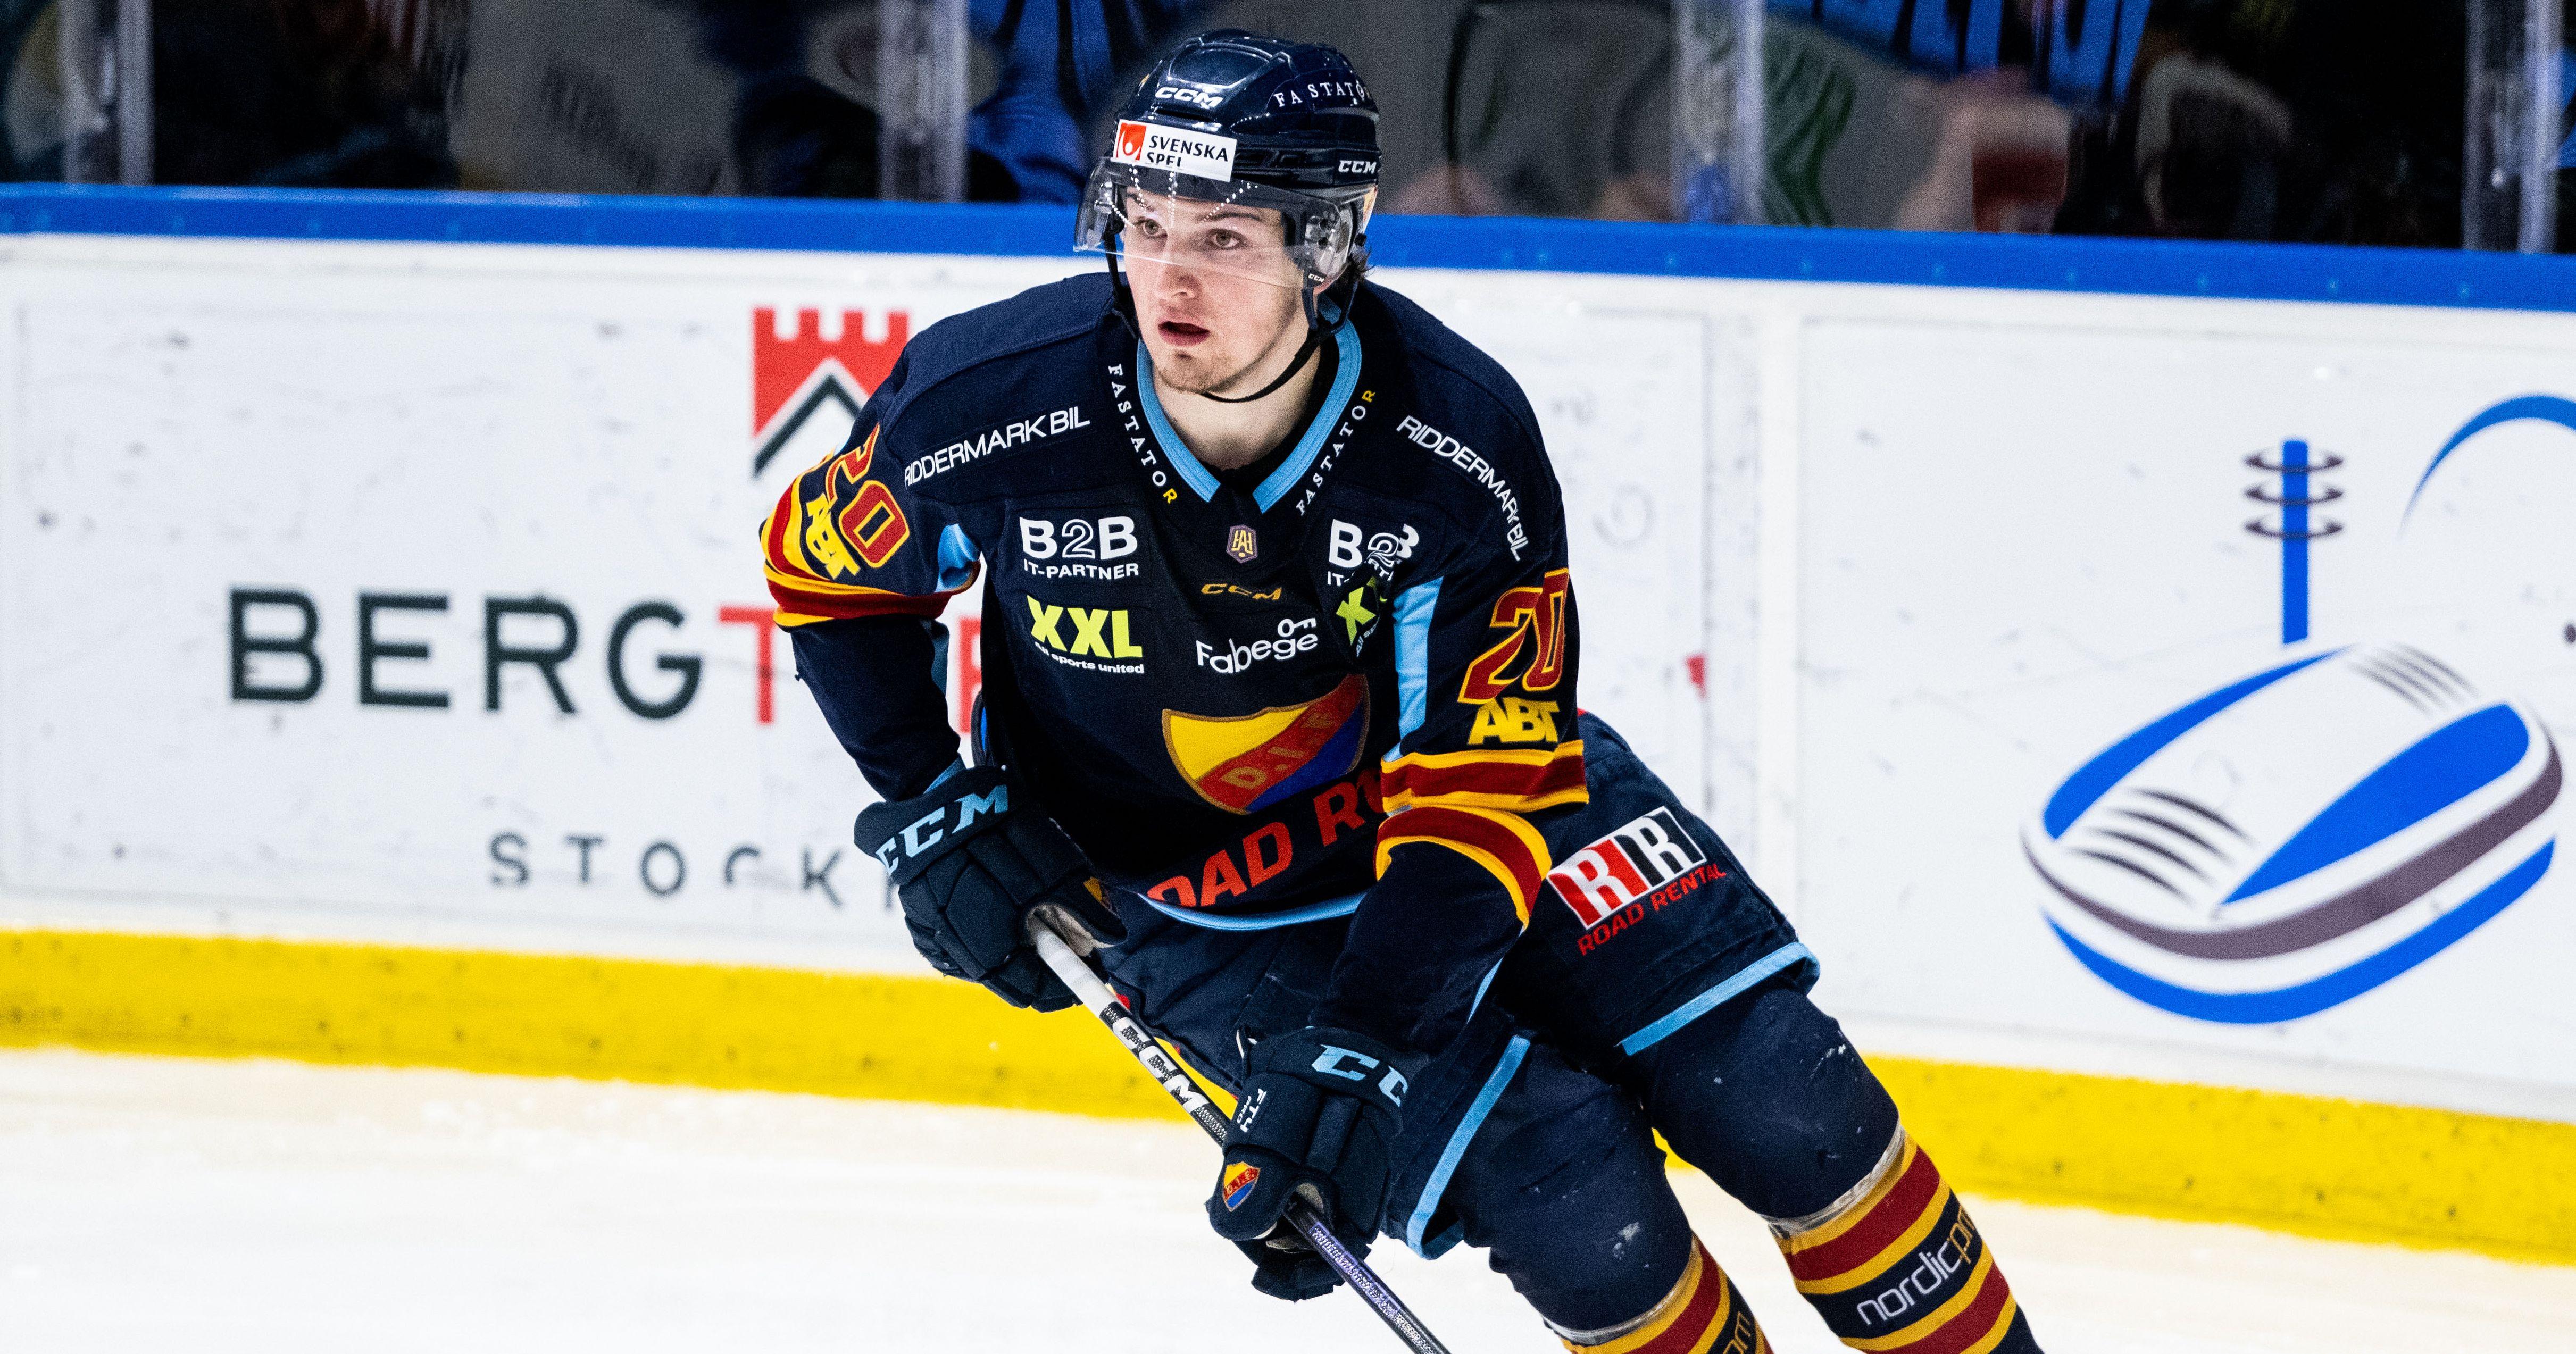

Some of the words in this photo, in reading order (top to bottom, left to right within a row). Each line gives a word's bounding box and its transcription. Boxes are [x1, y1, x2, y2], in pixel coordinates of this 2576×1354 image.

[1155, 87, 1223, 109] CCM
[1149, 135, 1228, 162] SVENSKA
[1338, 160, 1377, 174] CCM
[1308, 273, 1325, 283] CCM
[904, 415, 1047, 489] RIDDERMARK
[1049, 406, 1090, 435] BIL
[1108, 363, 1178, 504] FASTATOR
[1296, 390, 1375, 516] FASTATOR
[1019, 516, 1138, 560] B2B
[1506, 522, 1529, 562] BIL
[1024, 558, 1139, 580] IT-PARTNER
[1201, 583, 1282, 600] CCM
[1027, 595, 1143, 659] XXL
[1196, 633, 1319, 674] Fabege
[1051, 653, 1096, 670] sports
[1098, 664, 1144, 674] united
[875, 784, 1008, 876] CCM
[487, 829, 900, 912] STOCK
[1146, 821, 1293, 907] OAD
[1577, 902, 1645, 956] ROAD
[1650, 863, 1727, 912] RENTAL
[1112, 1016, 1211, 1114] CCM
[1311, 1044, 1409, 1108] CC
